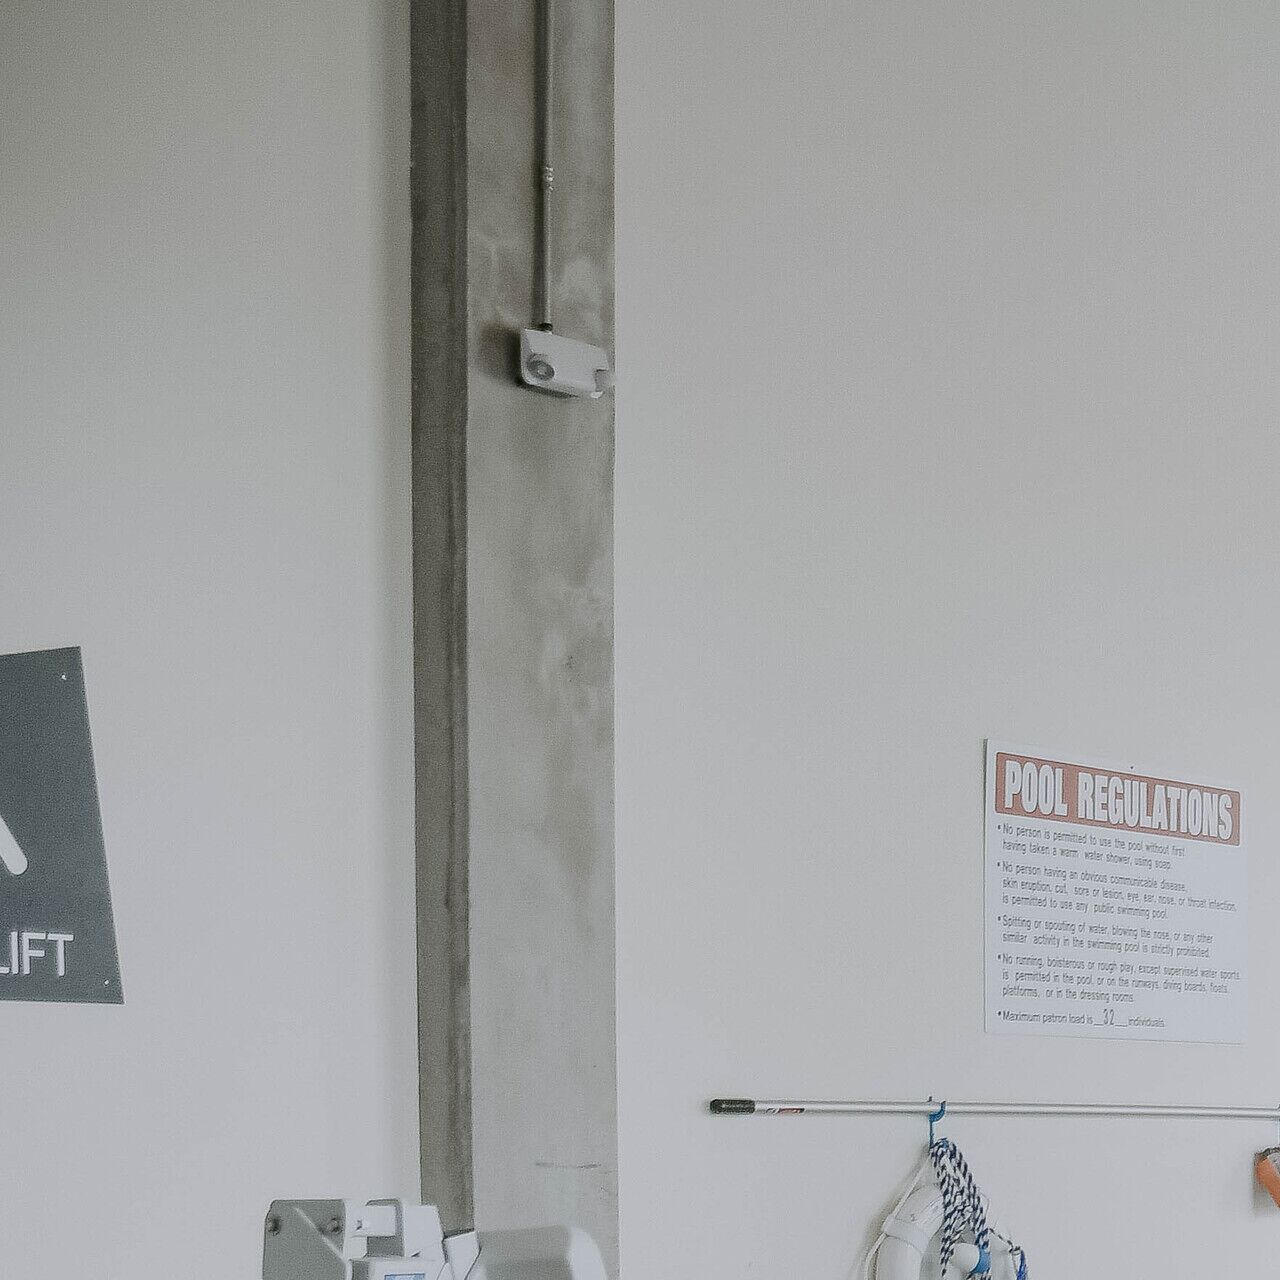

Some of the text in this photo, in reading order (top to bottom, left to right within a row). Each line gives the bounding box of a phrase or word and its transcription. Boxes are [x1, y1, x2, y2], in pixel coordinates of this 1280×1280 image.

[1005, 760, 1233, 841] POOL REGULATIONS
[1016, 827, 1041, 838] person
[1053, 832, 1087, 844] permitted
[1100, 838, 1112, 848] use
[1115, 838, 1126, 849] the
[1128, 841, 1143, 851] pool
[1146, 842, 1170, 855] without
[1171, 845, 1185, 856] first
[1003, 840, 1026, 854] having
[1029, 843, 1049, 855] taken
[1060, 848, 1079, 858] warm
[1085, 851, 1104, 861] water
[1135, 857, 1152, 869] using
[1016, 865, 1040, 876] person
[1044, 867, 1067, 881] having
[1081, 871, 1107, 883] obvious
[1110, 875, 1158, 889] communicable
[1003, 878, 1018, 889] skin
[1074, 886, 1089, 897] sore
[1187, 897, 1207, 908] throat
[1012, 895, 1047, 908] permitted
[1061, 901, 1073, 911] use
[1076, 902, 1088, 914] any
[1093, 902, 1115, 914] public
[1117, 906, 1149, 919] swimming
[1003, 915, 1031, 931] Spitting
[1045, 920, 1075, 934] spouting
[1112, 925, 1137, 940] blowing
[1141, 928, 1151, 938] the
[1183, 933, 1195, 944] any
[1197, 933, 1213, 944] other
[0, 931, 75, 977] IFT
[1003, 932, 1027, 943] similar
[1033, 935, 1060, 948] activity
[1073, 937, 1084, 948] the
[1087, 940, 1121, 953] swimming
[1125, 942, 1139, 952] pool
[1151, 944, 1173, 957] strictly
[1047, 956, 1085, 969] boisterous
[1098, 960, 1117, 974] rough
[1138, 965, 1160, 975] except
[1163, 966, 1198, 977] supervised
[1201, 969, 1217, 979] water
[1015, 971, 1050, 983] permitted
[1063, 972, 1074, 984] the
[1118, 977, 1129, 987] the
[1163, 979, 1182, 992] diving
[1066, 988, 1077, 999] the
[1080, 989, 1109, 1003] dressing
[1003, 1010, 1040, 1022] Maximum
[1043, 1013, 1067, 1024] patron
[1069, 1013, 1086, 1024] load
